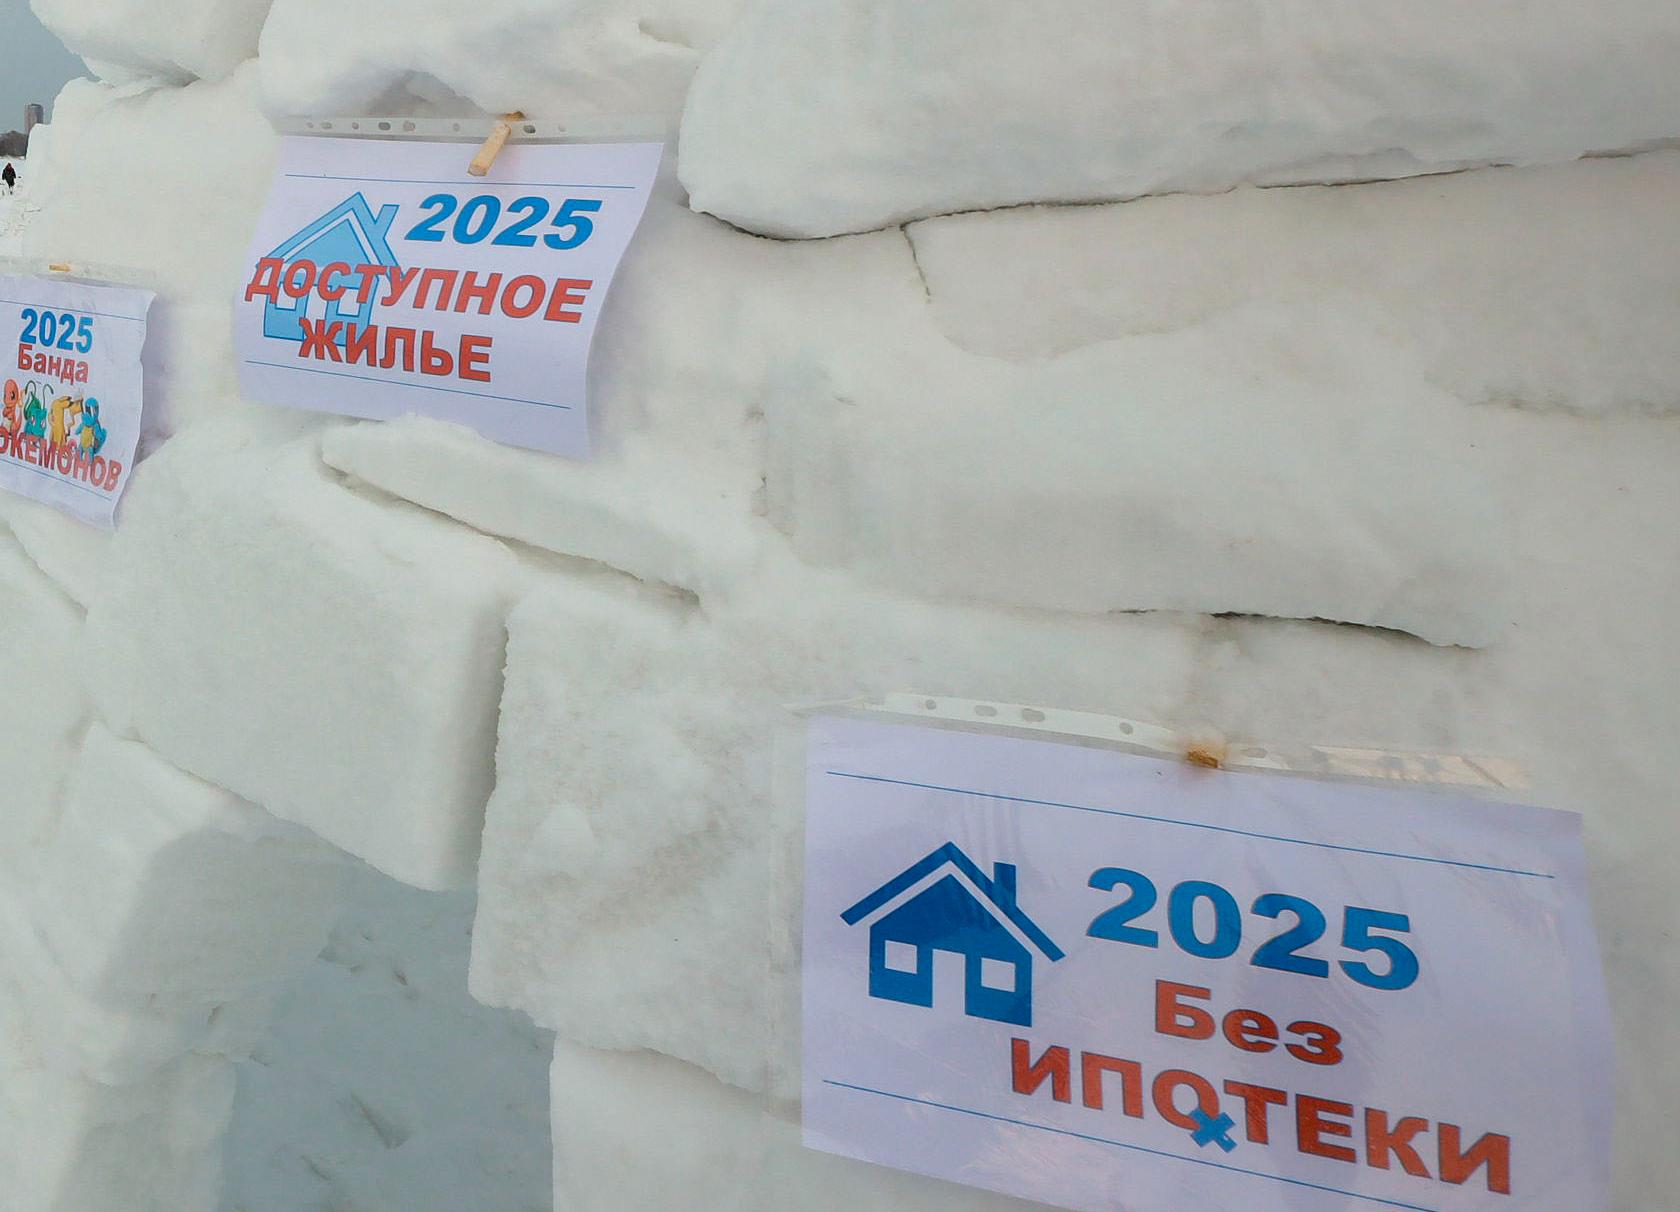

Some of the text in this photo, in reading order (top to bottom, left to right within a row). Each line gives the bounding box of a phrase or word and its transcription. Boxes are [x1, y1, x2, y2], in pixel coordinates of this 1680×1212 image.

[405, 193, 602, 250] 2025
[245, 257, 592, 323] ДОСТУПНОЕ
[20, 308, 94, 353] 2025
[298, 318, 493, 382] ЖИЛЬЕ
[17, 343, 89, 385] Банда
[1085, 866, 1421, 992] 2025
[1153, 979, 1344, 1066] Без
[1011, 1037, 1512, 1196] ИПОТЕКИ
